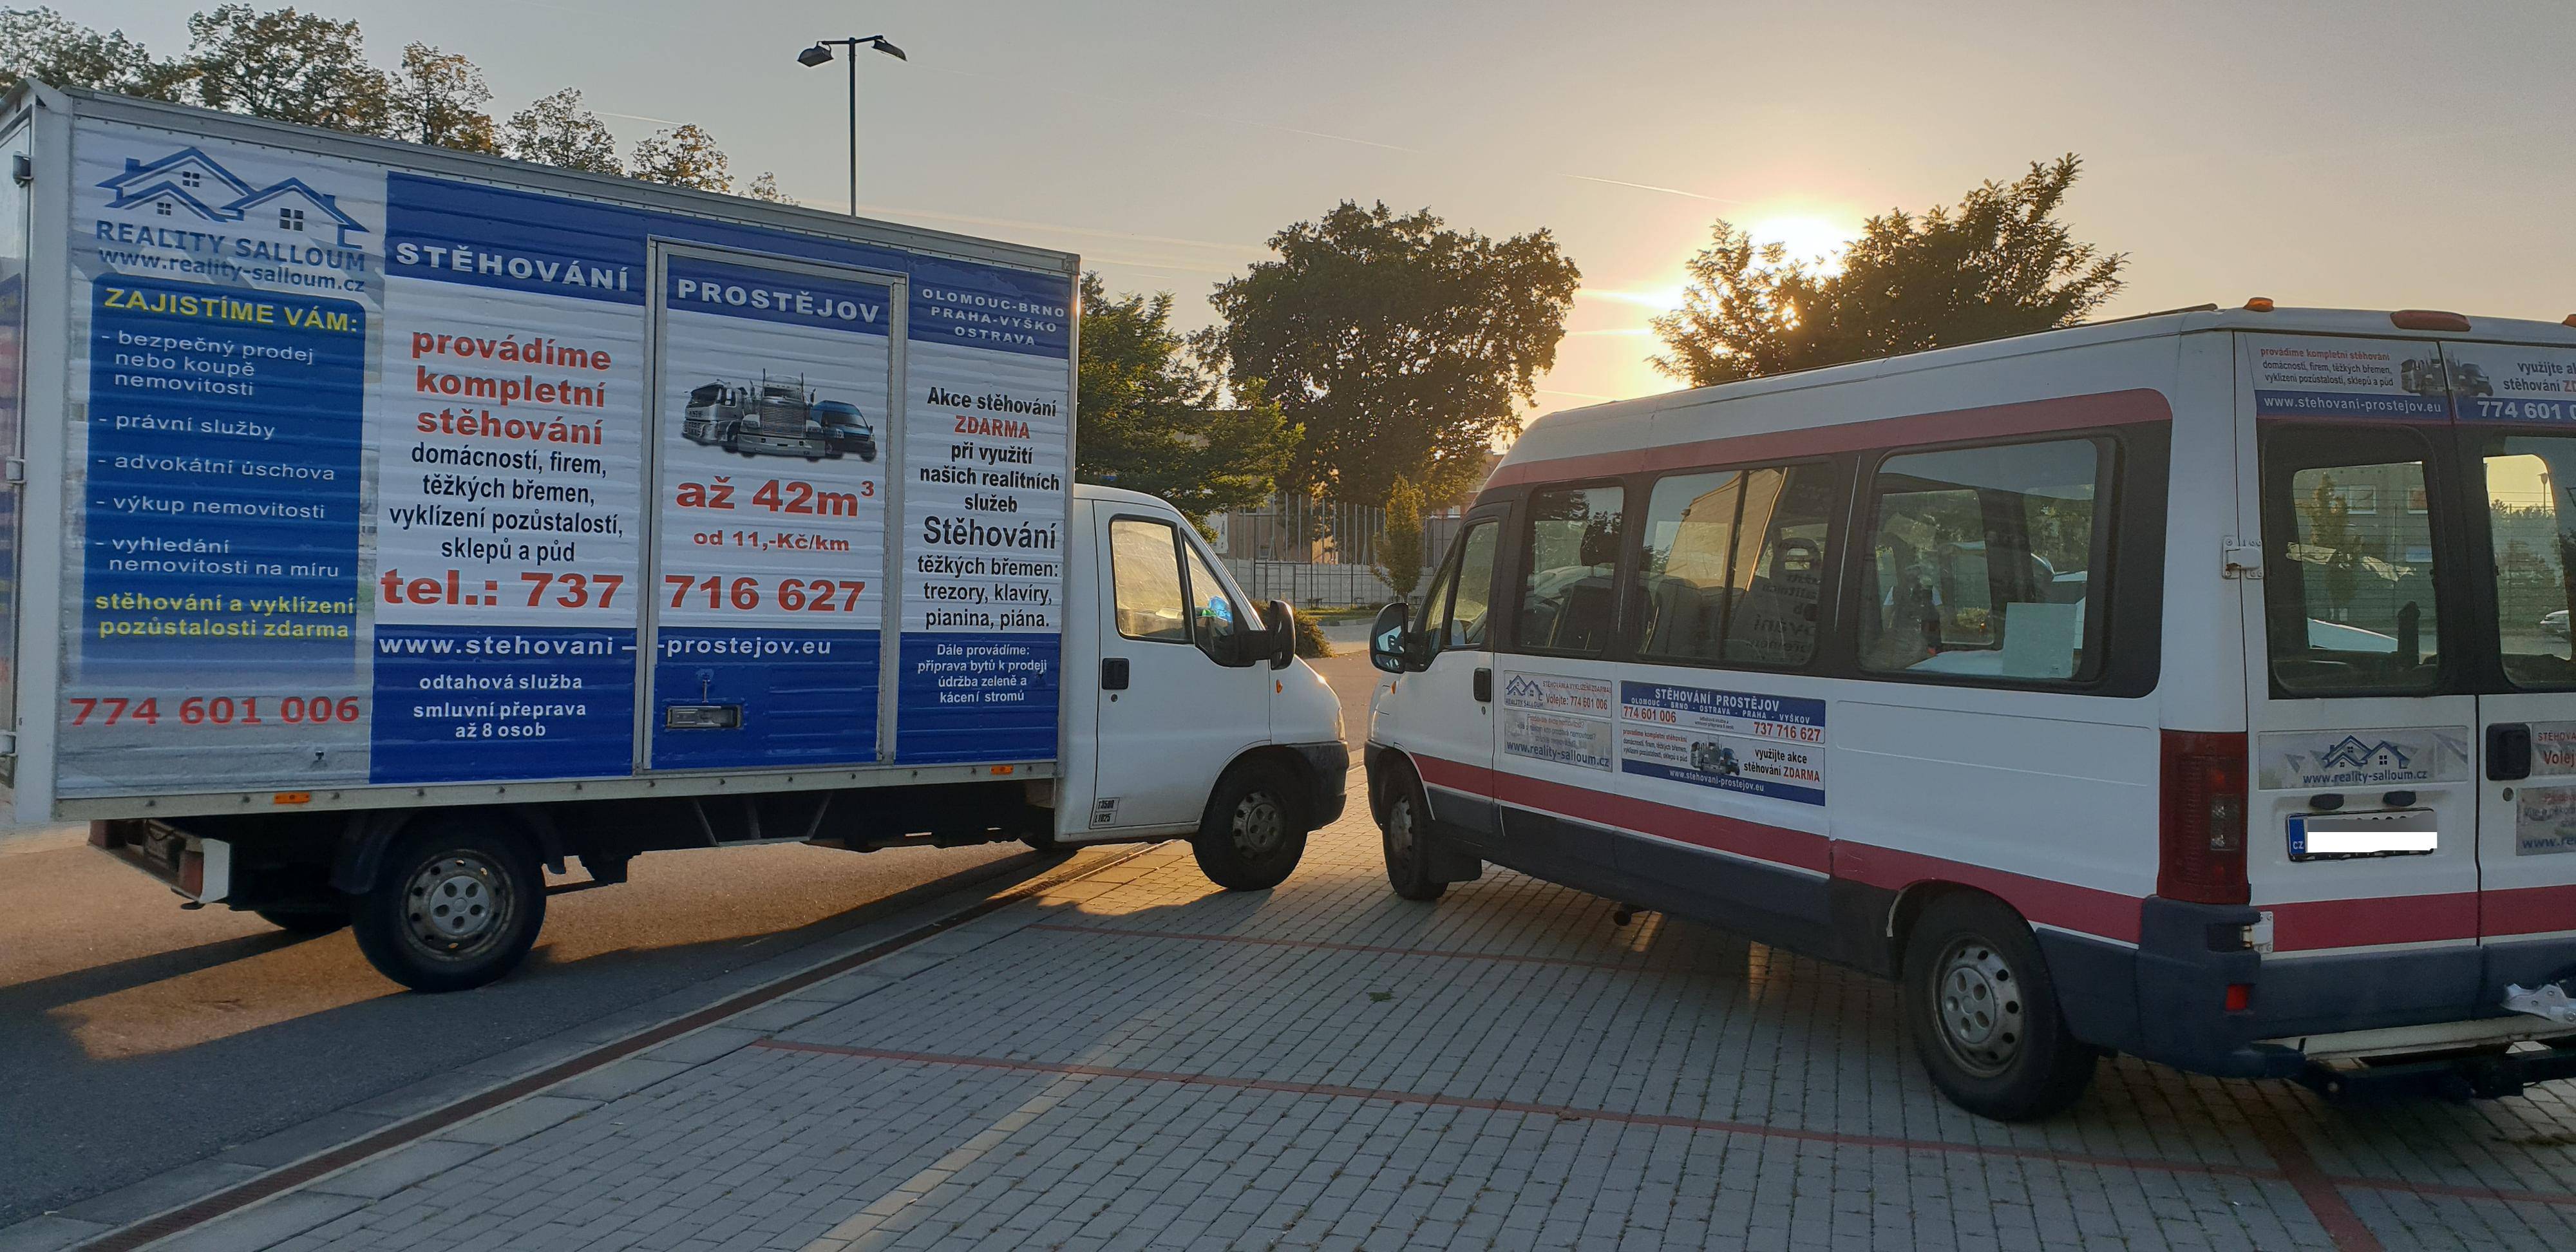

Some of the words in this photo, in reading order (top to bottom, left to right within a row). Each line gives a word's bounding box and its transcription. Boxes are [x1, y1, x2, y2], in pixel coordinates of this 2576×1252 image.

[96, 220, 226, 254] REALITY
[235, 238, 365, 272] SALLOUM
[99, 247, 366, 293] www.reality-salloum.cz
[396, 242, 629, 292] STĚHOVÁNÍ
[677, 278, 879, 323] PROSTĚJOV
[104, 287, 274, 323] ZAJISTÍME
[285, 306, 358, 332] VÁM:
[922, 289, 1065, 318] OLOMOUC-BRNO
[931, 306, 1057, 333] PRAHA-VYŠKO
[118, 330, 234, 357] bezpečný
[243, 341, 314, 365] prodej
[954, 326, 1036, 346] OSTRAVA
[412, 330, 612, 372] provádíme
[115, 352, 176, 370] nebo
[184, 355, 255, 377] koupě
[2517, 361, 2563, 377] využijte
[114, 372, 254, 396] nemovitosti
[416, 365, 606, 408] kompletní
[2503, 377, 2561, 392] stěhování
[927, 386, 972, 408] Akce
[977, 394, 1057, 417] stěhování
[2264, 397, 2441, 414] www.stehovani-prostejov.eu
[2477, 401, 2519, 419] 774
[2524, 403, 2561, 420] 601
[116, 414, 193, 432] právní
[201, 419, 275, 440] služby
[417, 408, 603, 446] stěhování
[954, 415, 1031, 439] ZDARMA
[549, 450, 607, 479] firem,
[951, 441, 974, 463] při
[979, 446, 1033, 466] využití
[114, 455, 233, 475] advokátní
[242, 461, 335, 481] úschova
[920, 465, 978, 486] našich
[982, 471, 1060, 491] realitních
[422, 474, 506, 503] těžkých
[513, 479, 595, 507] břemen,
[676, 475, 735, 509] až
[113, 496, 185, 517] výkup
[193, 498, 325, 518] nemovitosti
[964, 493, 1018, 514] služeb
[390, 504, 486, 530] vyklízení
[694, 529, 723, 546] od
[733, 530, 850, 552] 11,-Kč/km
[923, 515, 1057, 549] Stěhování
[112, 537, 231, 555] vyhledání
[441, 536, 512, 565] sklepů
[518, 545, 529, 560] a
[536, 539, 575, 565] půd
[109, 557, 248, 576] nemovitosti
[256, 563, 282, 576] na
[290, 562, 339, 578] míru
[918, 555, 985, 578] těžkých
[991, 557, 1059, 578] břemen:
[380, 569, 498, 606] tel.:
[520, 572, 624, 609] 737
[665, 575, 760, 611] 716
[777, 579, 866, 612] 627
[923, 582, 989, 605] trezory,
[994, 583, 1053, 606] klavíry,
[95, 593, 222, 612] stěhování
[230, 598, 242, 612] a
[250, 596, 355, 617] vyklízení
[99, 617, 257, 638] pozůstalosti
[264, 621, 349, 638] zdarma
[925, 608, 995, 630] pianina,
[1000, 609, 1050, 631] piána.
[937, 643, 963, 656] Dále
[967, 643, 1030, 658] provádíme:
[917, 659, 967, 675] příprava
[971, 658, 996, 673] bytů
[999, 659, 1005, 670] k
[1008, 659, 1048, 674] prodeji
[419, 674, 513, 690] odtahová
[519, 674, 583, 690] služba
[938, 676, 979, 688] údržba
[981, 674, 1018, 688] zeleně
[1021, 678, 1027, 687] a
[940, 691, 980, 704] kácení
[984, 689, 1025, 703] stromů
[1546, 693, 1569, 707] Volejte:
[1570, 696, 1582, 707] 774
[1583, 697, 1594, 708] 601
[1596, 699, 1608, 710] 006
[1655, 687, 1711, 705] STĚHOVÁNÍ
[1716, 695, 1779, 712] PROSTĚJOV
[70, 697, 160, 726] 774
[178, 696, 262, 725] 601
[280, 696, 360, 723] 006
[413, 702, 494, 719] smluvní
[500, 702, 587, 721] přeprava
[1624, 706, 1639, 718] 774
[1642, 708, 1656, 721] 601
[1660, 710, 1676, 723] 006
[1631, 697, 1660, 707] OLOMOUC
[1700, 705, 1730, 716] OSTRAVA
[1743, 710, 1766, 719] PRAHA
[1779, 714, 1810, 725] VYŠKOV
[455, 723, 477, 739] až
[482, 724, 493, 737] 8
[498, 722, 546, 737] osob
[1754, 721, 1774, 735] 737
[1777, 724, 1797, 738] 716
[1800, 726, 1821, 741] 627
[1506, 741, 1610, 767] www.reality-salloum.cz
[1755, 748, 1785, 763] využijte
[1787, 752, 1808, 764] akce
[1744, 762, 1781, 777] stěhování
[1783, 766, 1820, 782] ZDARMA
[2302, 770, 2427, 784] www.reality-salloum.cz
[2293, 840, 2304, 849] CZ
